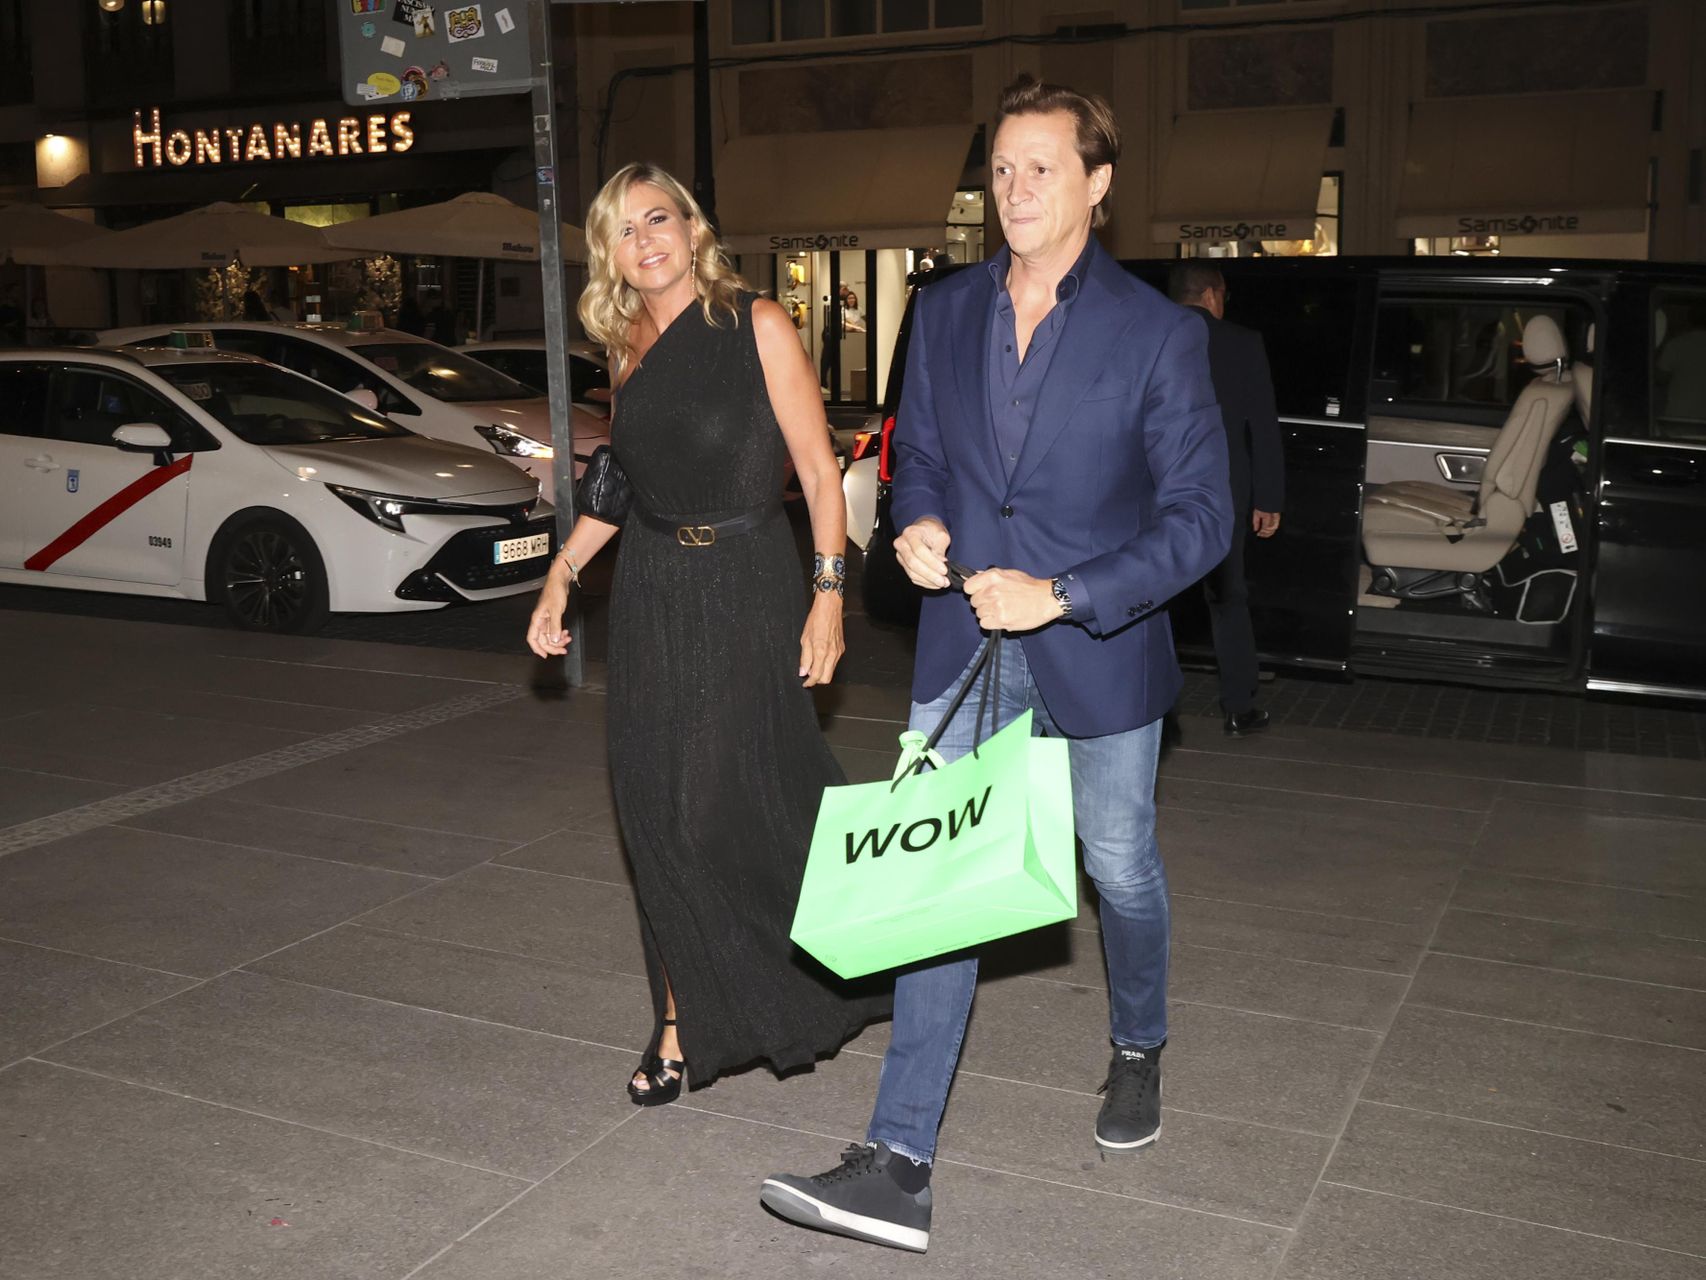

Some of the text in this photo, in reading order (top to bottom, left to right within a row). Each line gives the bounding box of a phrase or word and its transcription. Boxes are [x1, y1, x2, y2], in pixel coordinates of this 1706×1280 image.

[133, 106, 414, 168] HONTANARES
[1179, 222, 1287, 240] Samsonite
[1458, 215, 1579, 234] Samsonite
[769, 233, 859, 250] Samsonite
[503, 540, 528, 560] 9668
[846, 784, 992, 865] WOW
[1121, 1050, 1145, 1060] PRADA
